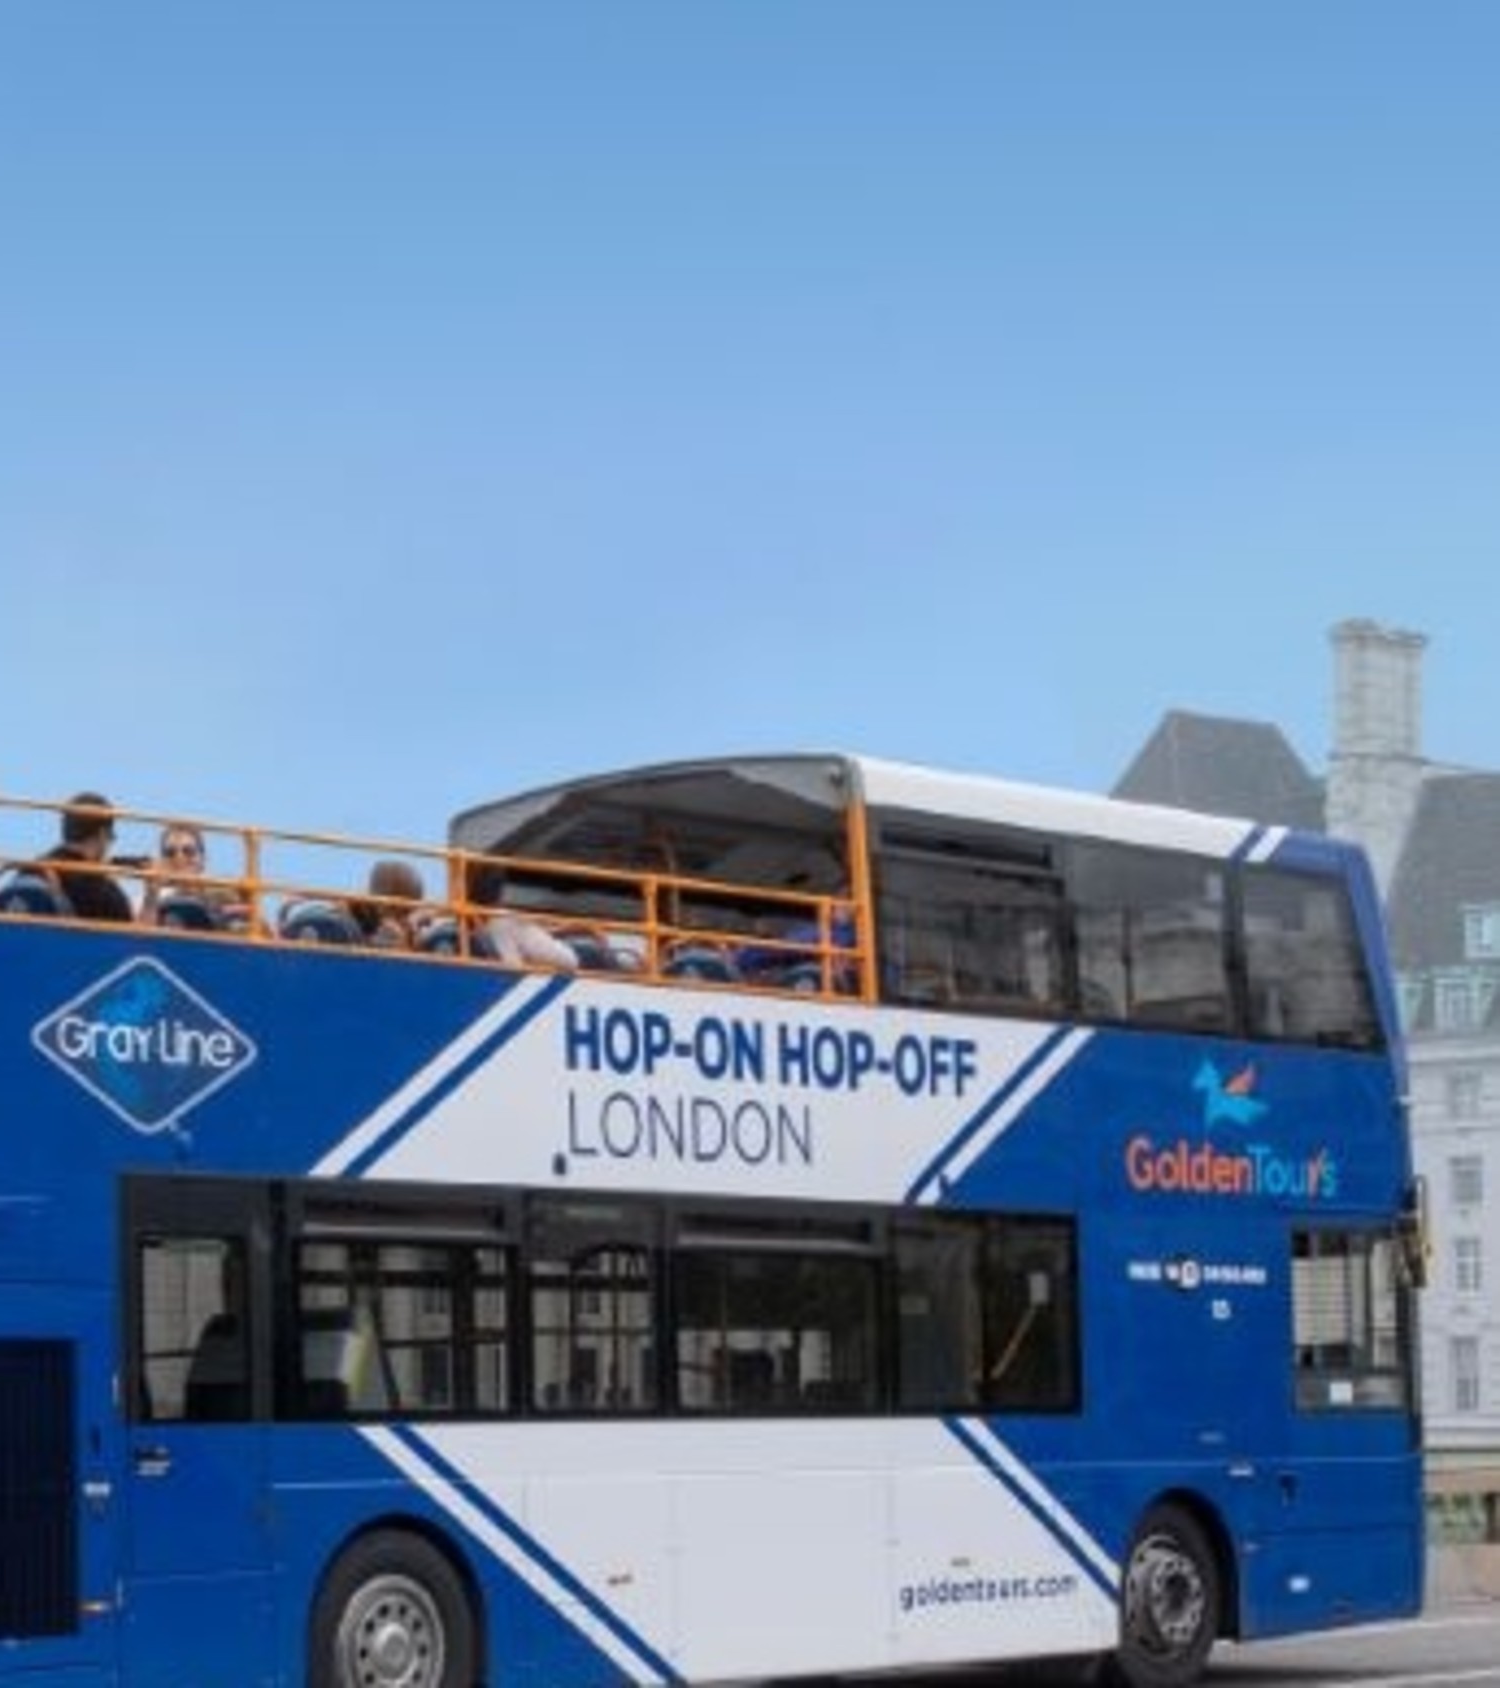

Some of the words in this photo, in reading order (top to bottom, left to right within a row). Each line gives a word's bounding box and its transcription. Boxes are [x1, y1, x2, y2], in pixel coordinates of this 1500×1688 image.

[563, 1003, 765, 1084] HOP-ON
[779, 1023, 978, 1099] HOP-OFF
[566, 1089, 815, 1166] LONDON
[1125, 1135, 1338, 1202] GoldenTours
[900, 1574, 1078, 1611] goldentours.com
